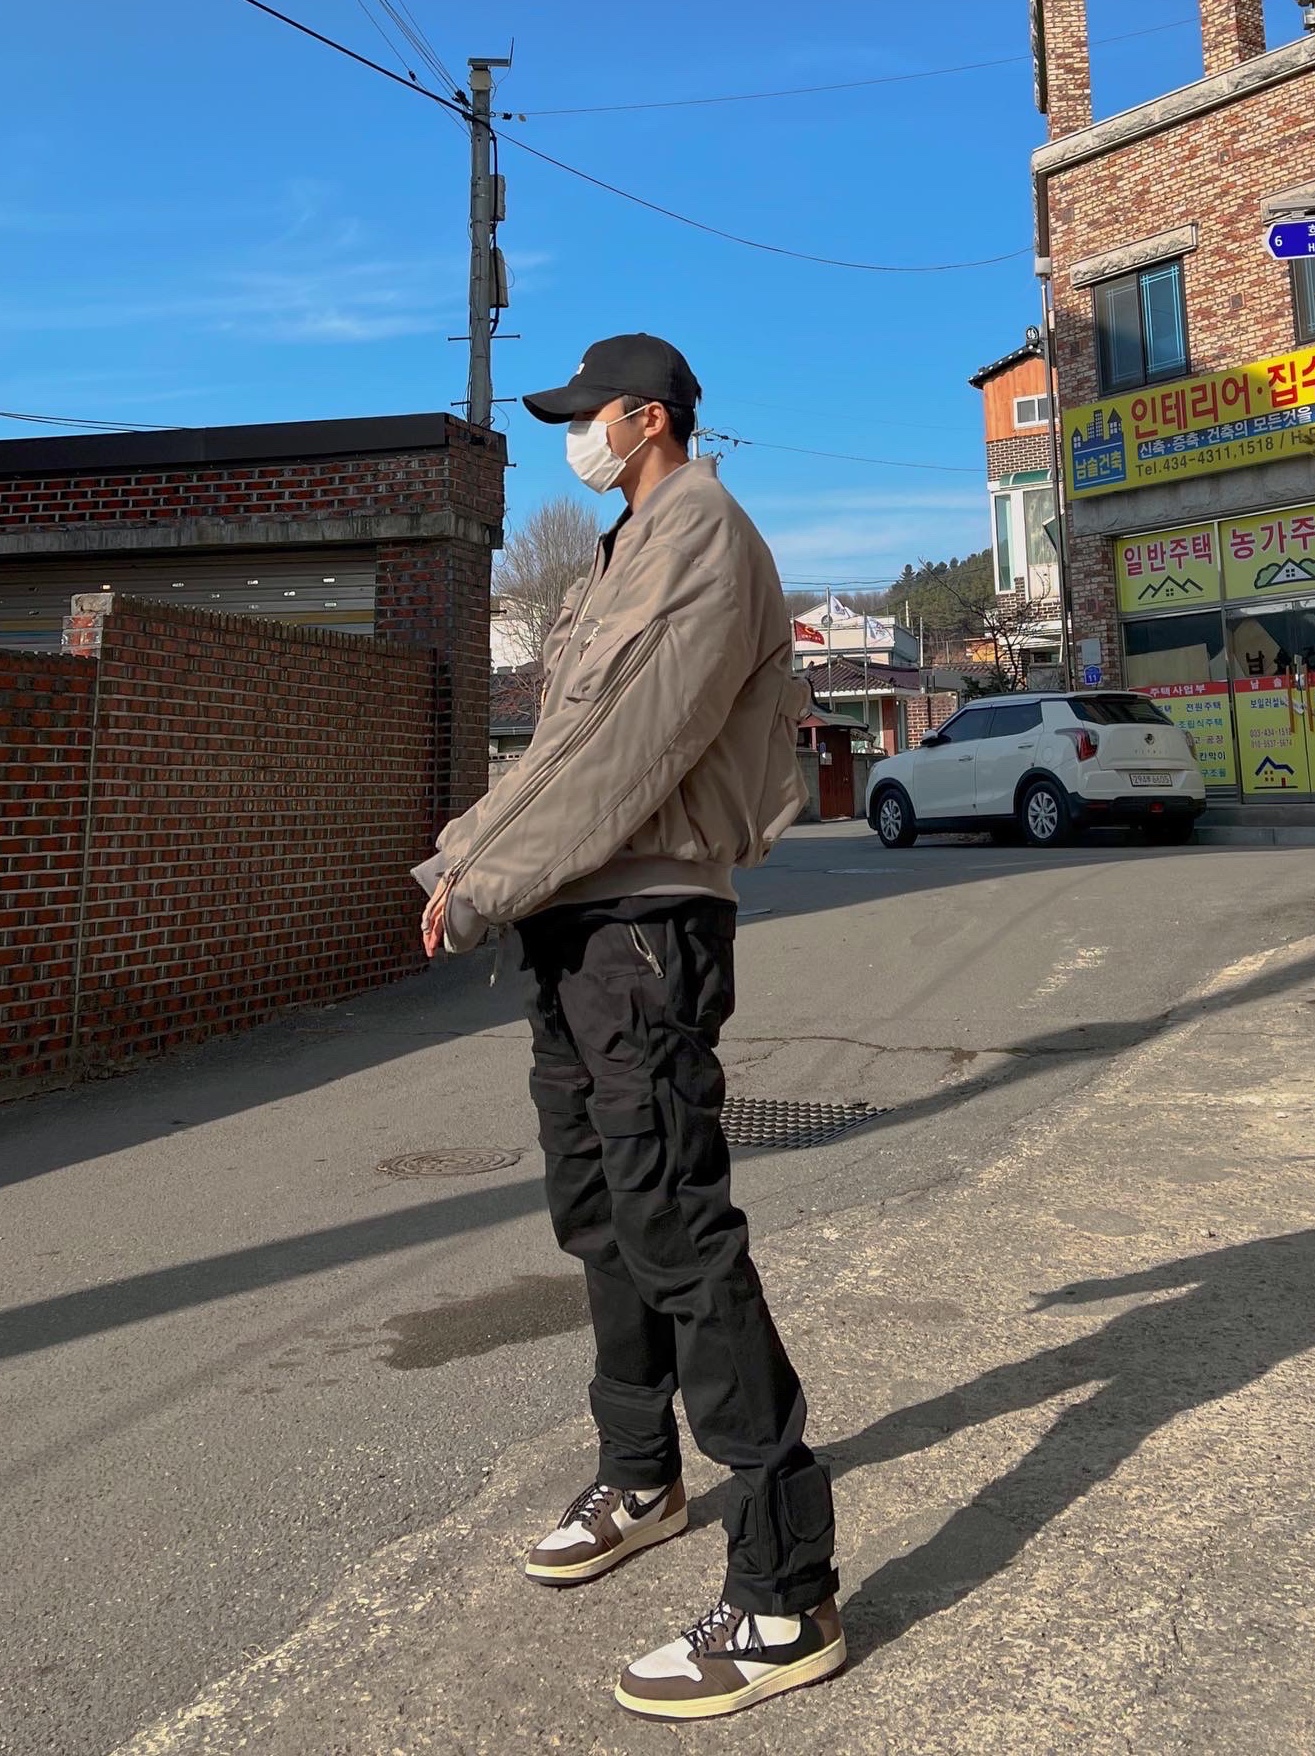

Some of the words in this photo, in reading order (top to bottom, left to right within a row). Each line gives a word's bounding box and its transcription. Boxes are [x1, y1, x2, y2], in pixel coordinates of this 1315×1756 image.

[1274, 235, 1283, 247] 6
[1075, 450, 1122, 481] 남솔건축
[1124, 532, 1212, 577] 일반주택
